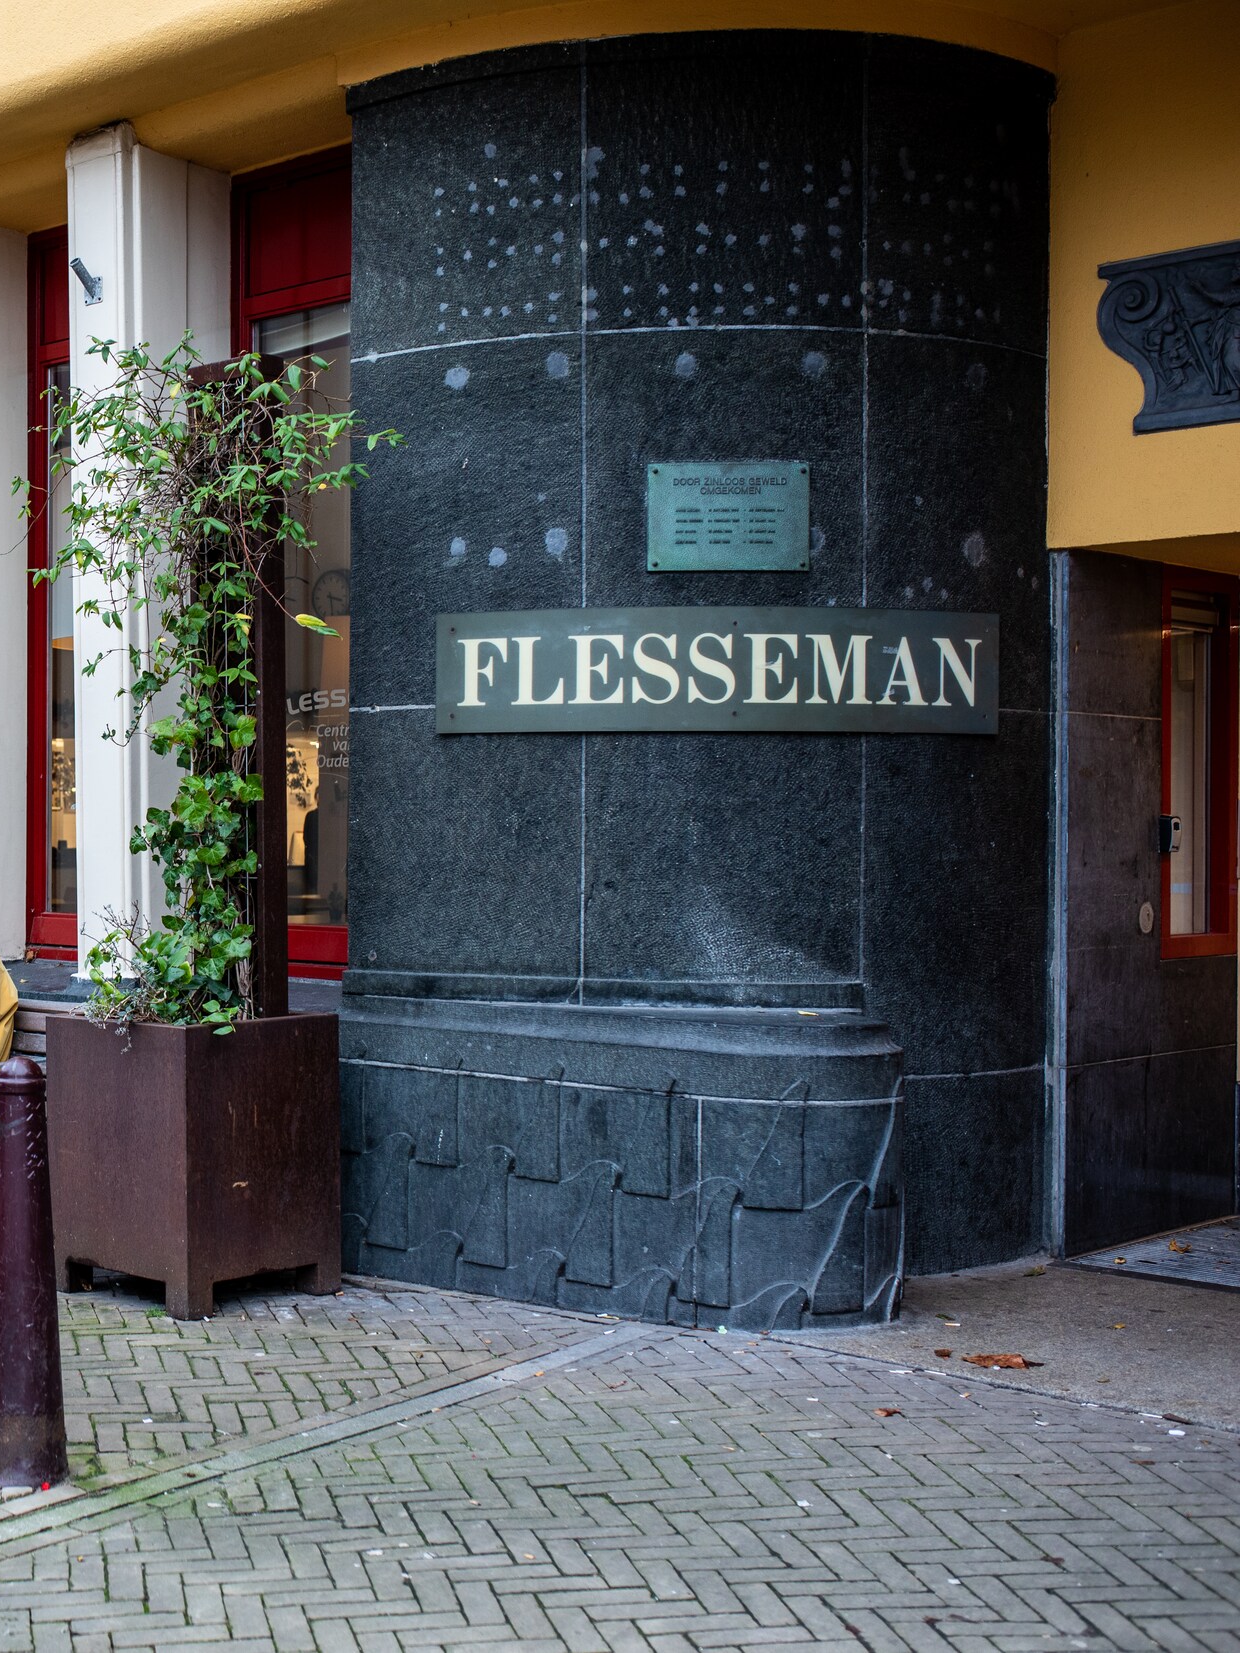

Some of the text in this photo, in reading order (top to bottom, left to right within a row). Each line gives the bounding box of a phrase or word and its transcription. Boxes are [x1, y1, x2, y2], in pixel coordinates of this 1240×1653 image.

[673, 477, 788, 486] DOOR ZINLOOS GEWELD
[700, 486, 762, 495] OMGEKOMEN
[456, 632, 982, 707] FLESSEMAN
[286, 688, 350, 715] LESS
